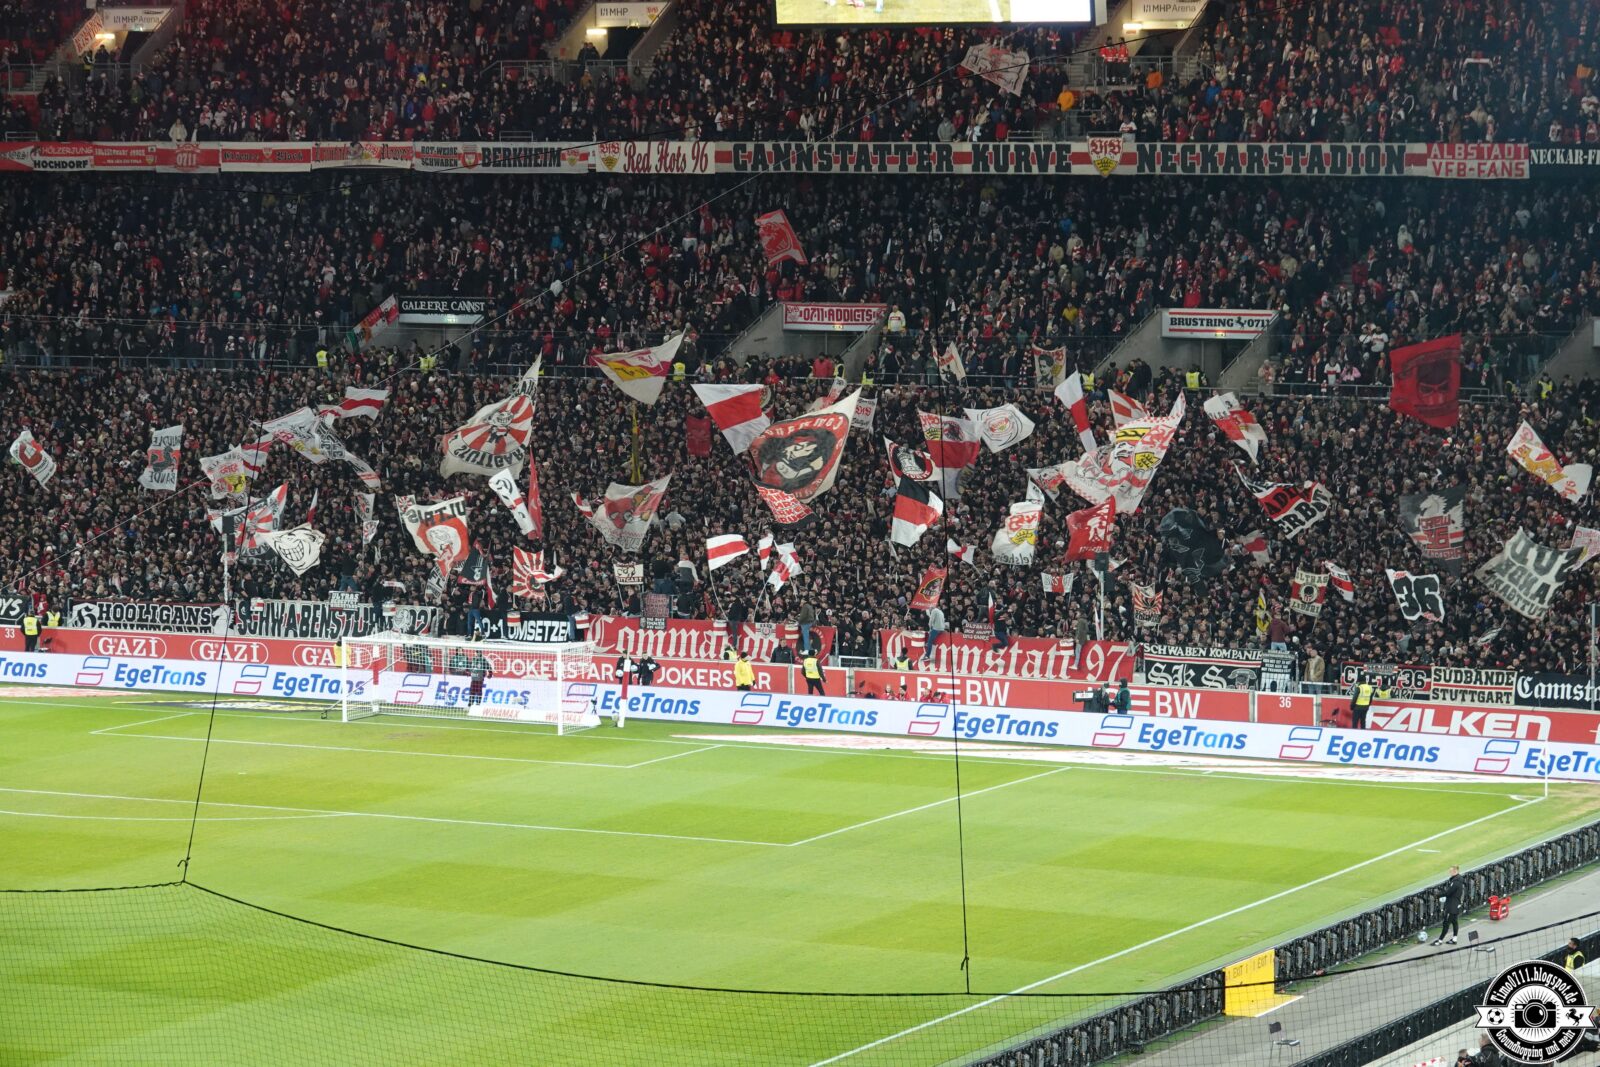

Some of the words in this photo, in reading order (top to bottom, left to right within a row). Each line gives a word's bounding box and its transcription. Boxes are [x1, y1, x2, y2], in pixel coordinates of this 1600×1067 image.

[609, 8, 629, 16] MHP
[1152, 4, 1171, 13] MHP
[1172, 4, 1196, 12] Arena
[122, 15, 138, 23] MHP
[482, 147, 561, 167] BERKHEIM
[623, 140, 652, 173] Red
[655, 138, 687, 173] Hots
[692, 140, 709, 173] 96
[1090, 138, 1124, 157] VfB
[1430, 143, 1529, 159] ALBSTADT
[34, 160, 88, 169] HOCHDORF
[421, 157, 458, 167] SCHWABEN
[733, 143, 954, 173] CANNSTATTER
[971, 143, 1073, 173] KURVE
[1138, 143, 1407, 175] NECKARSTADION
[1432, 160, 1525, 177] VFB-FANS
[401, 301, 449, 312] GALEERE
[803, 308, 825, 321] 0711
[828, 309, 873, 322] ADDICTS
[1170, 317, 1234, 327] BRUSTRING
[1392, 574, 1441, 618] 36
[97, 602, 212, 625] HOOLIGANS
[4, 628, 15, 639] 33
[1144, 643, 1207, 657] SCHWABEN
[1209, 648, 1262, 661] KOMPANIE
[1086, 644, 1129, 682] 97
[114, 663, 207, 688] EgeTrans
[1401, 669, 1427, 689] 36
[1279, 696, 1292, 708] 36
[1432, 688, 1513, 704] STUTTGART
[776, 700, 879, 727] EgeTrans
[953, 711, 1059, 738] EgeTrans
[1366, 706, 1552, 741] FALKEN
[1138, 722, 1248, 750] EgeTrans
[1327, 735, 1440, 763] EgeTrans
